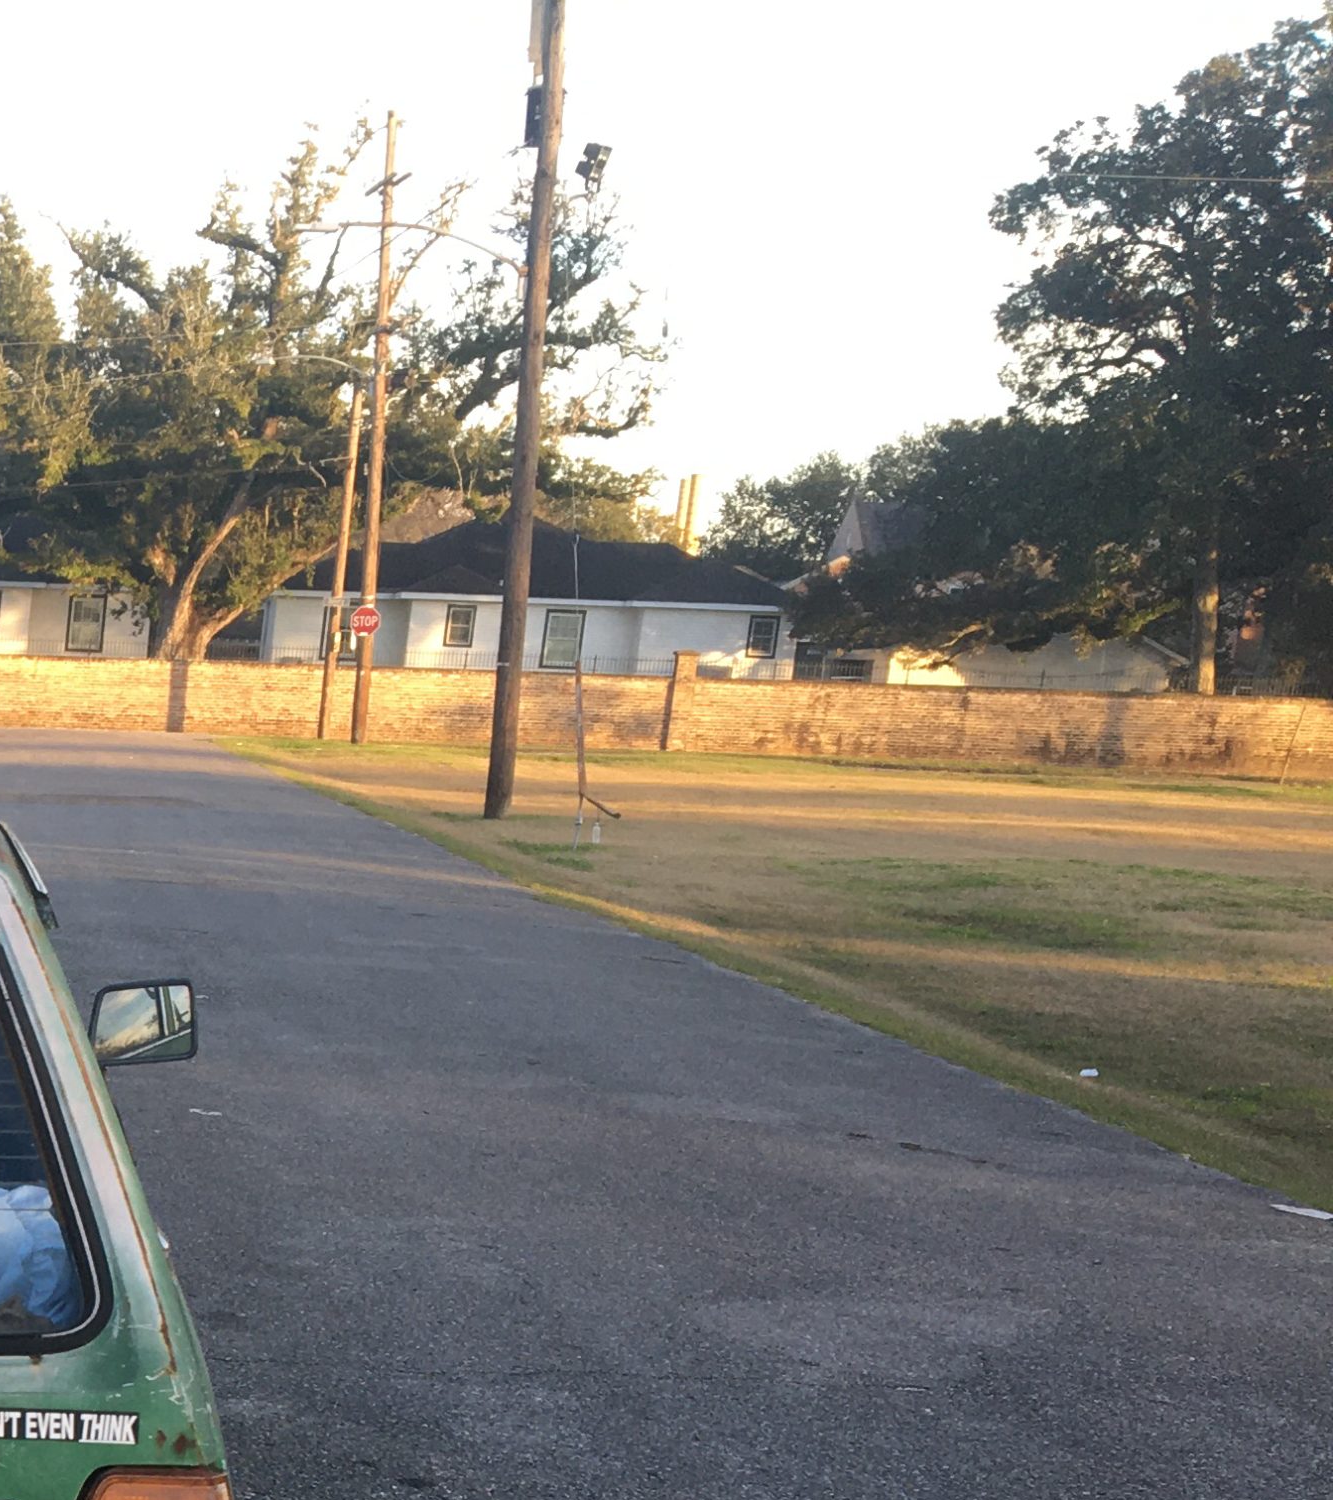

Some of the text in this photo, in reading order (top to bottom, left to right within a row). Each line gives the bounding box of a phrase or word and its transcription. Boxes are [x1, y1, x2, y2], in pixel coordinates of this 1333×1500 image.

[353, 615, 378, 627] STOP
[25, 1412, 75, 1441] EVEN
[79, 1413, 137, 1445] THINK
